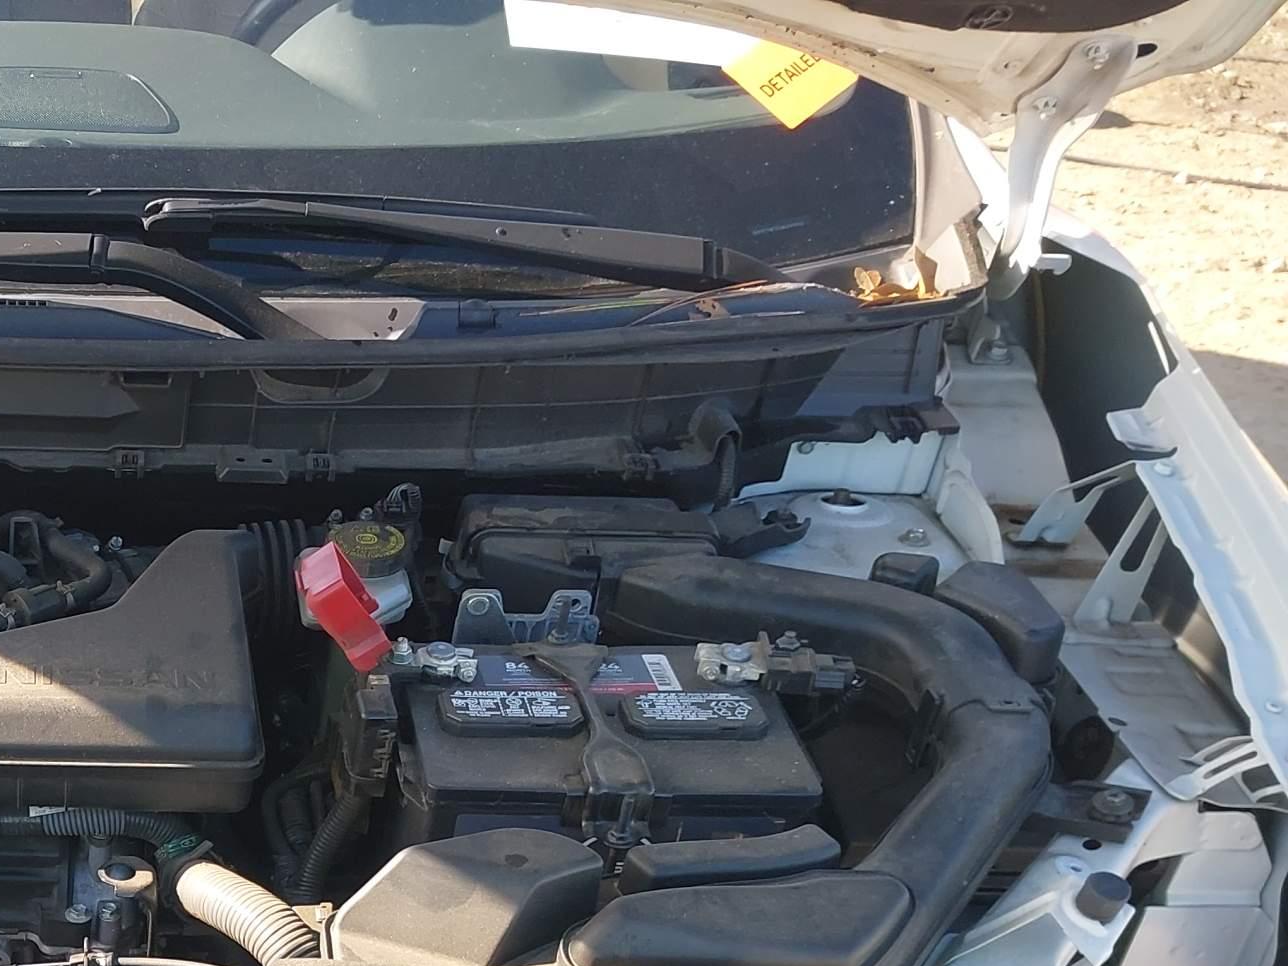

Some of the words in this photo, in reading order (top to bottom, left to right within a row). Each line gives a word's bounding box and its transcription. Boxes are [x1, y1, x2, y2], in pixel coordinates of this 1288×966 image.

[505, 661, 530, 669] 84
[464, 690, 508, 698] DANGER
[518, 690, 558, 698] POISON
